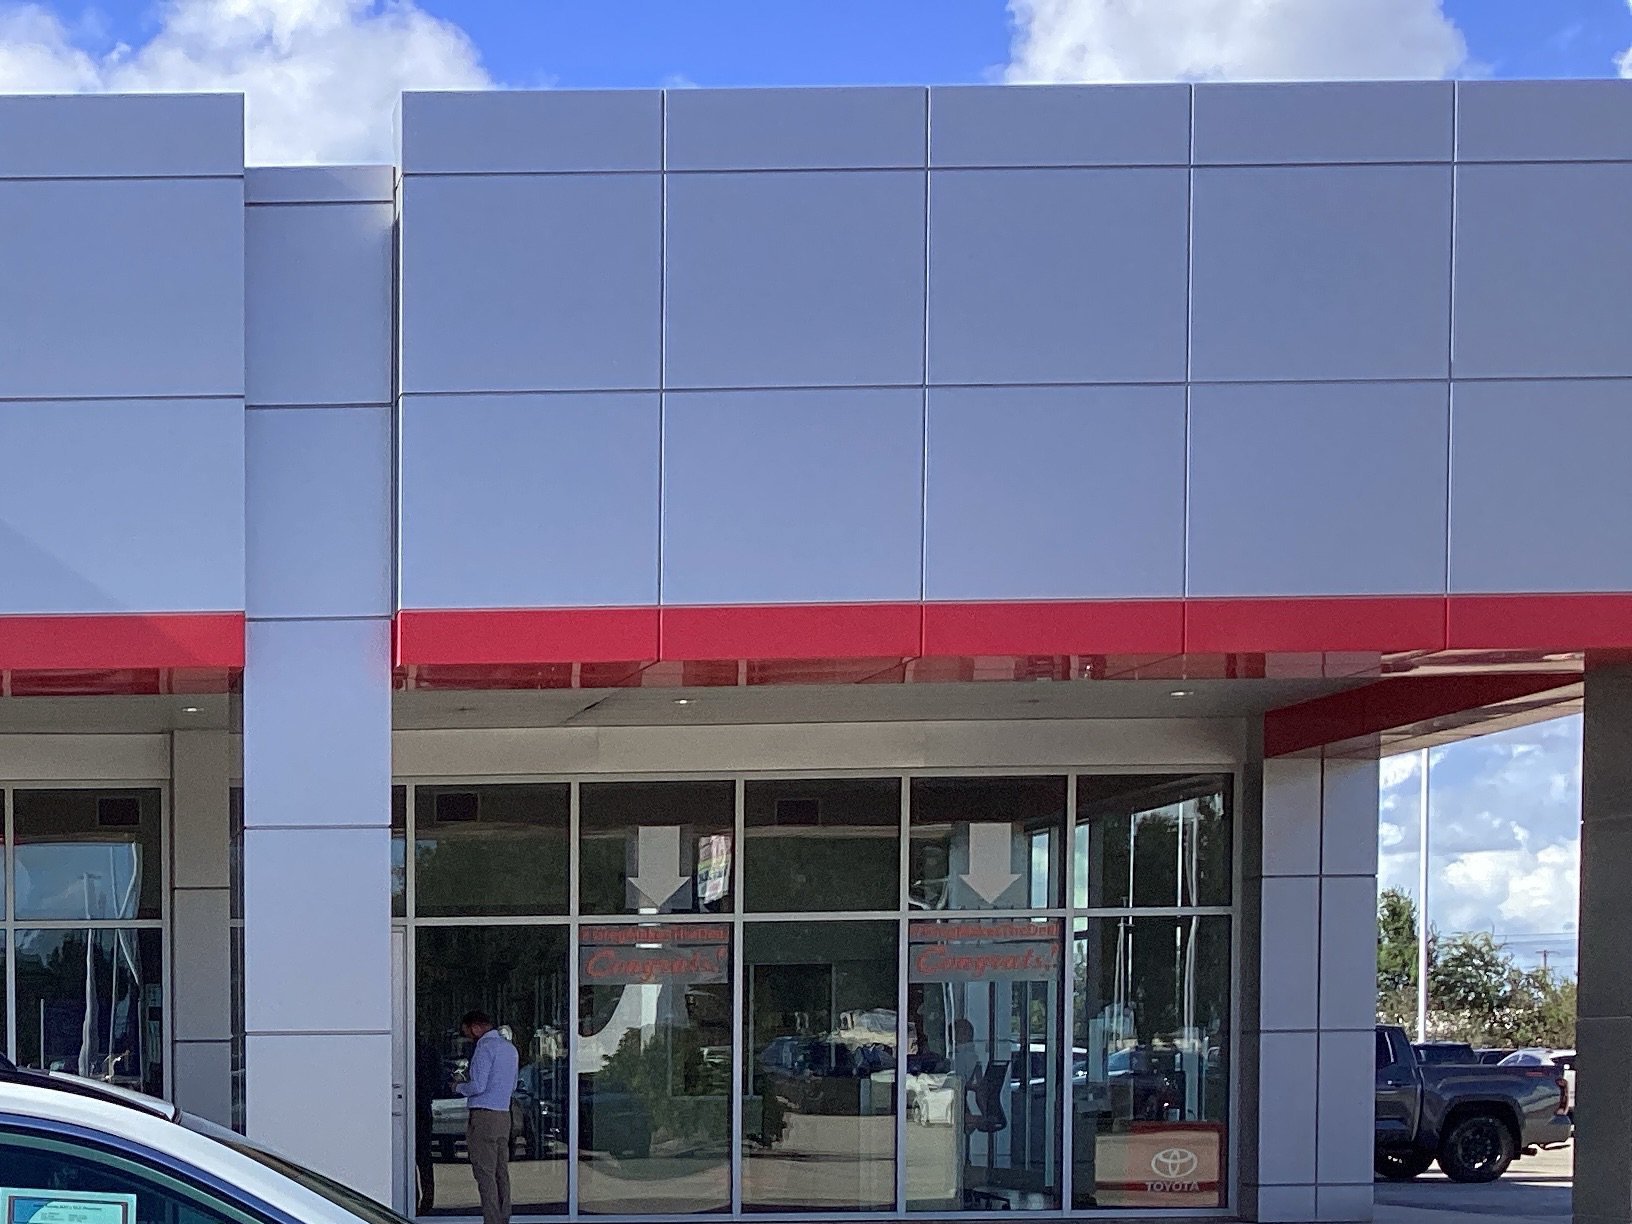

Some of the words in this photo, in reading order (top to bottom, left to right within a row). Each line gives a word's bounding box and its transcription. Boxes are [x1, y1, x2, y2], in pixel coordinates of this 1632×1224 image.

[585, 945, 728, 981] Congrats!
[916, 942, 1059, 979] Congrats!
[1145, 1181, 1200, 1192] TOYOTA
